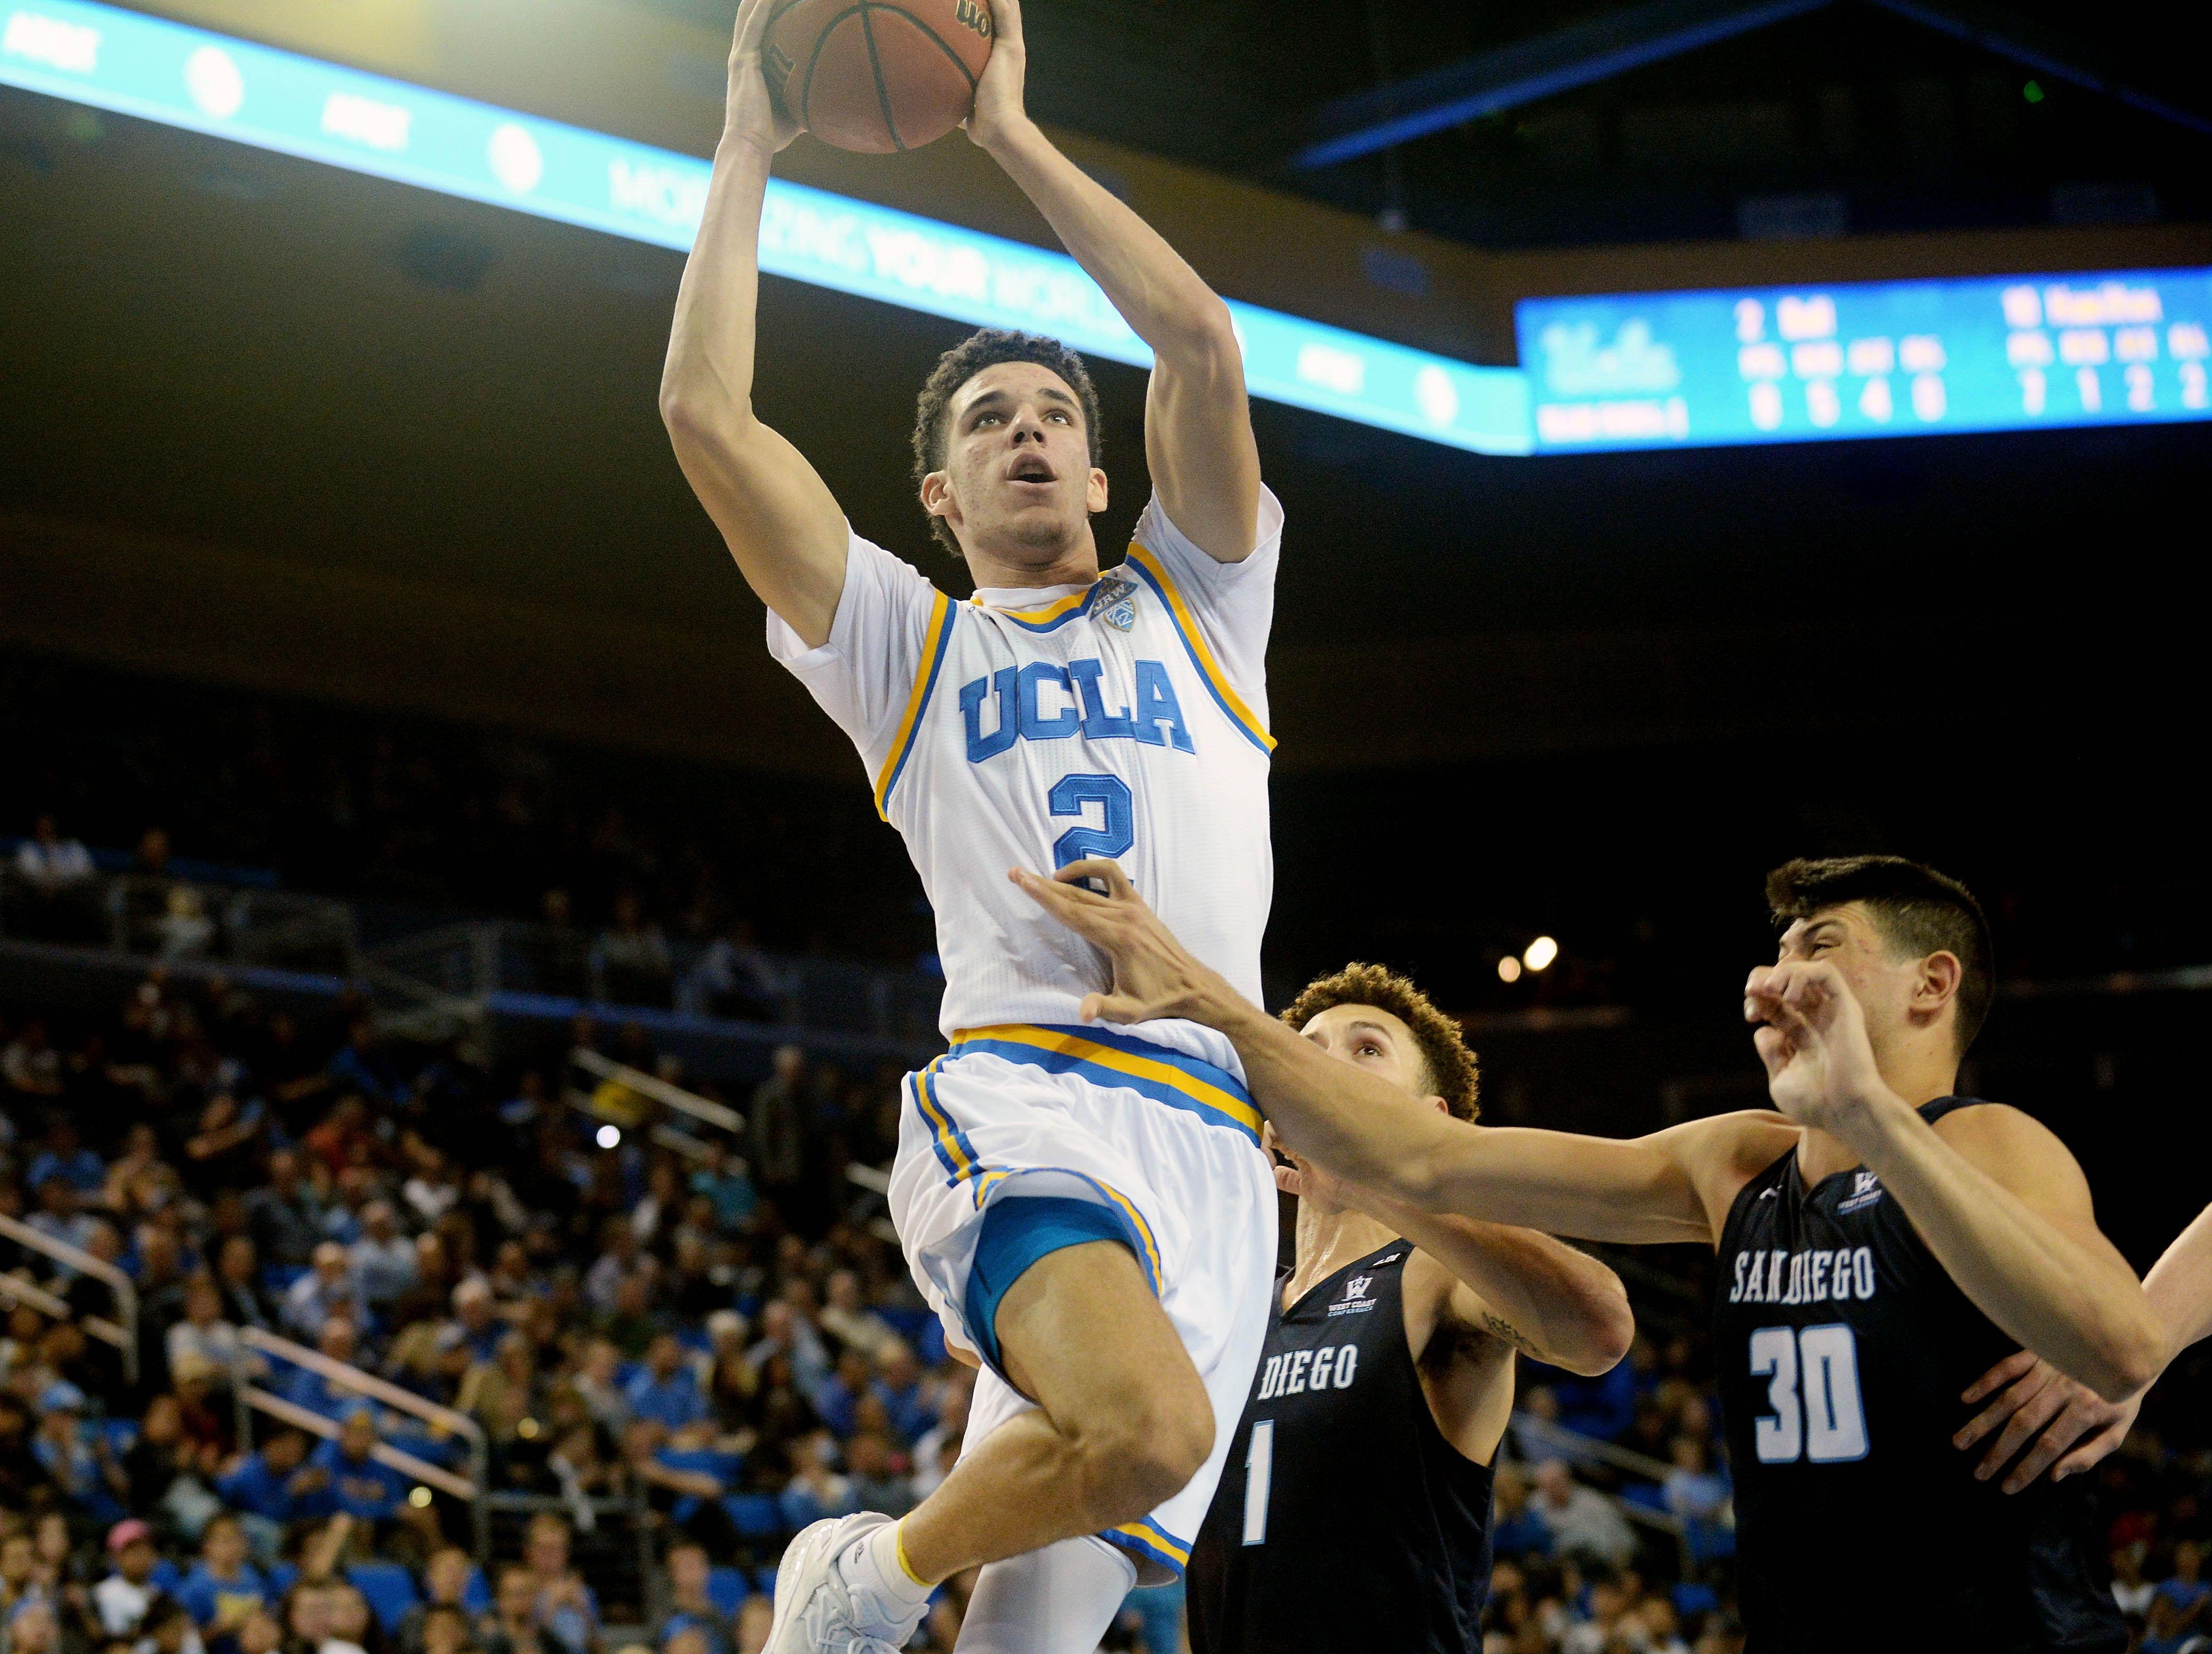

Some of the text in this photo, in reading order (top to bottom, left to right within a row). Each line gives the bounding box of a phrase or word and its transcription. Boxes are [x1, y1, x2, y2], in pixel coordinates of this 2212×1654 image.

[960, 658, 1195, 763] UCLA
[1049, 774, 1134, 897] 2
[1729, 1246, 1876, 1305] SAN DIEGO
[1257, 1343, 1358, 1401] DIEGO
[1749, 1322, 1870, 1464] 30
[1242, 1419, 1274, 1546] 1
